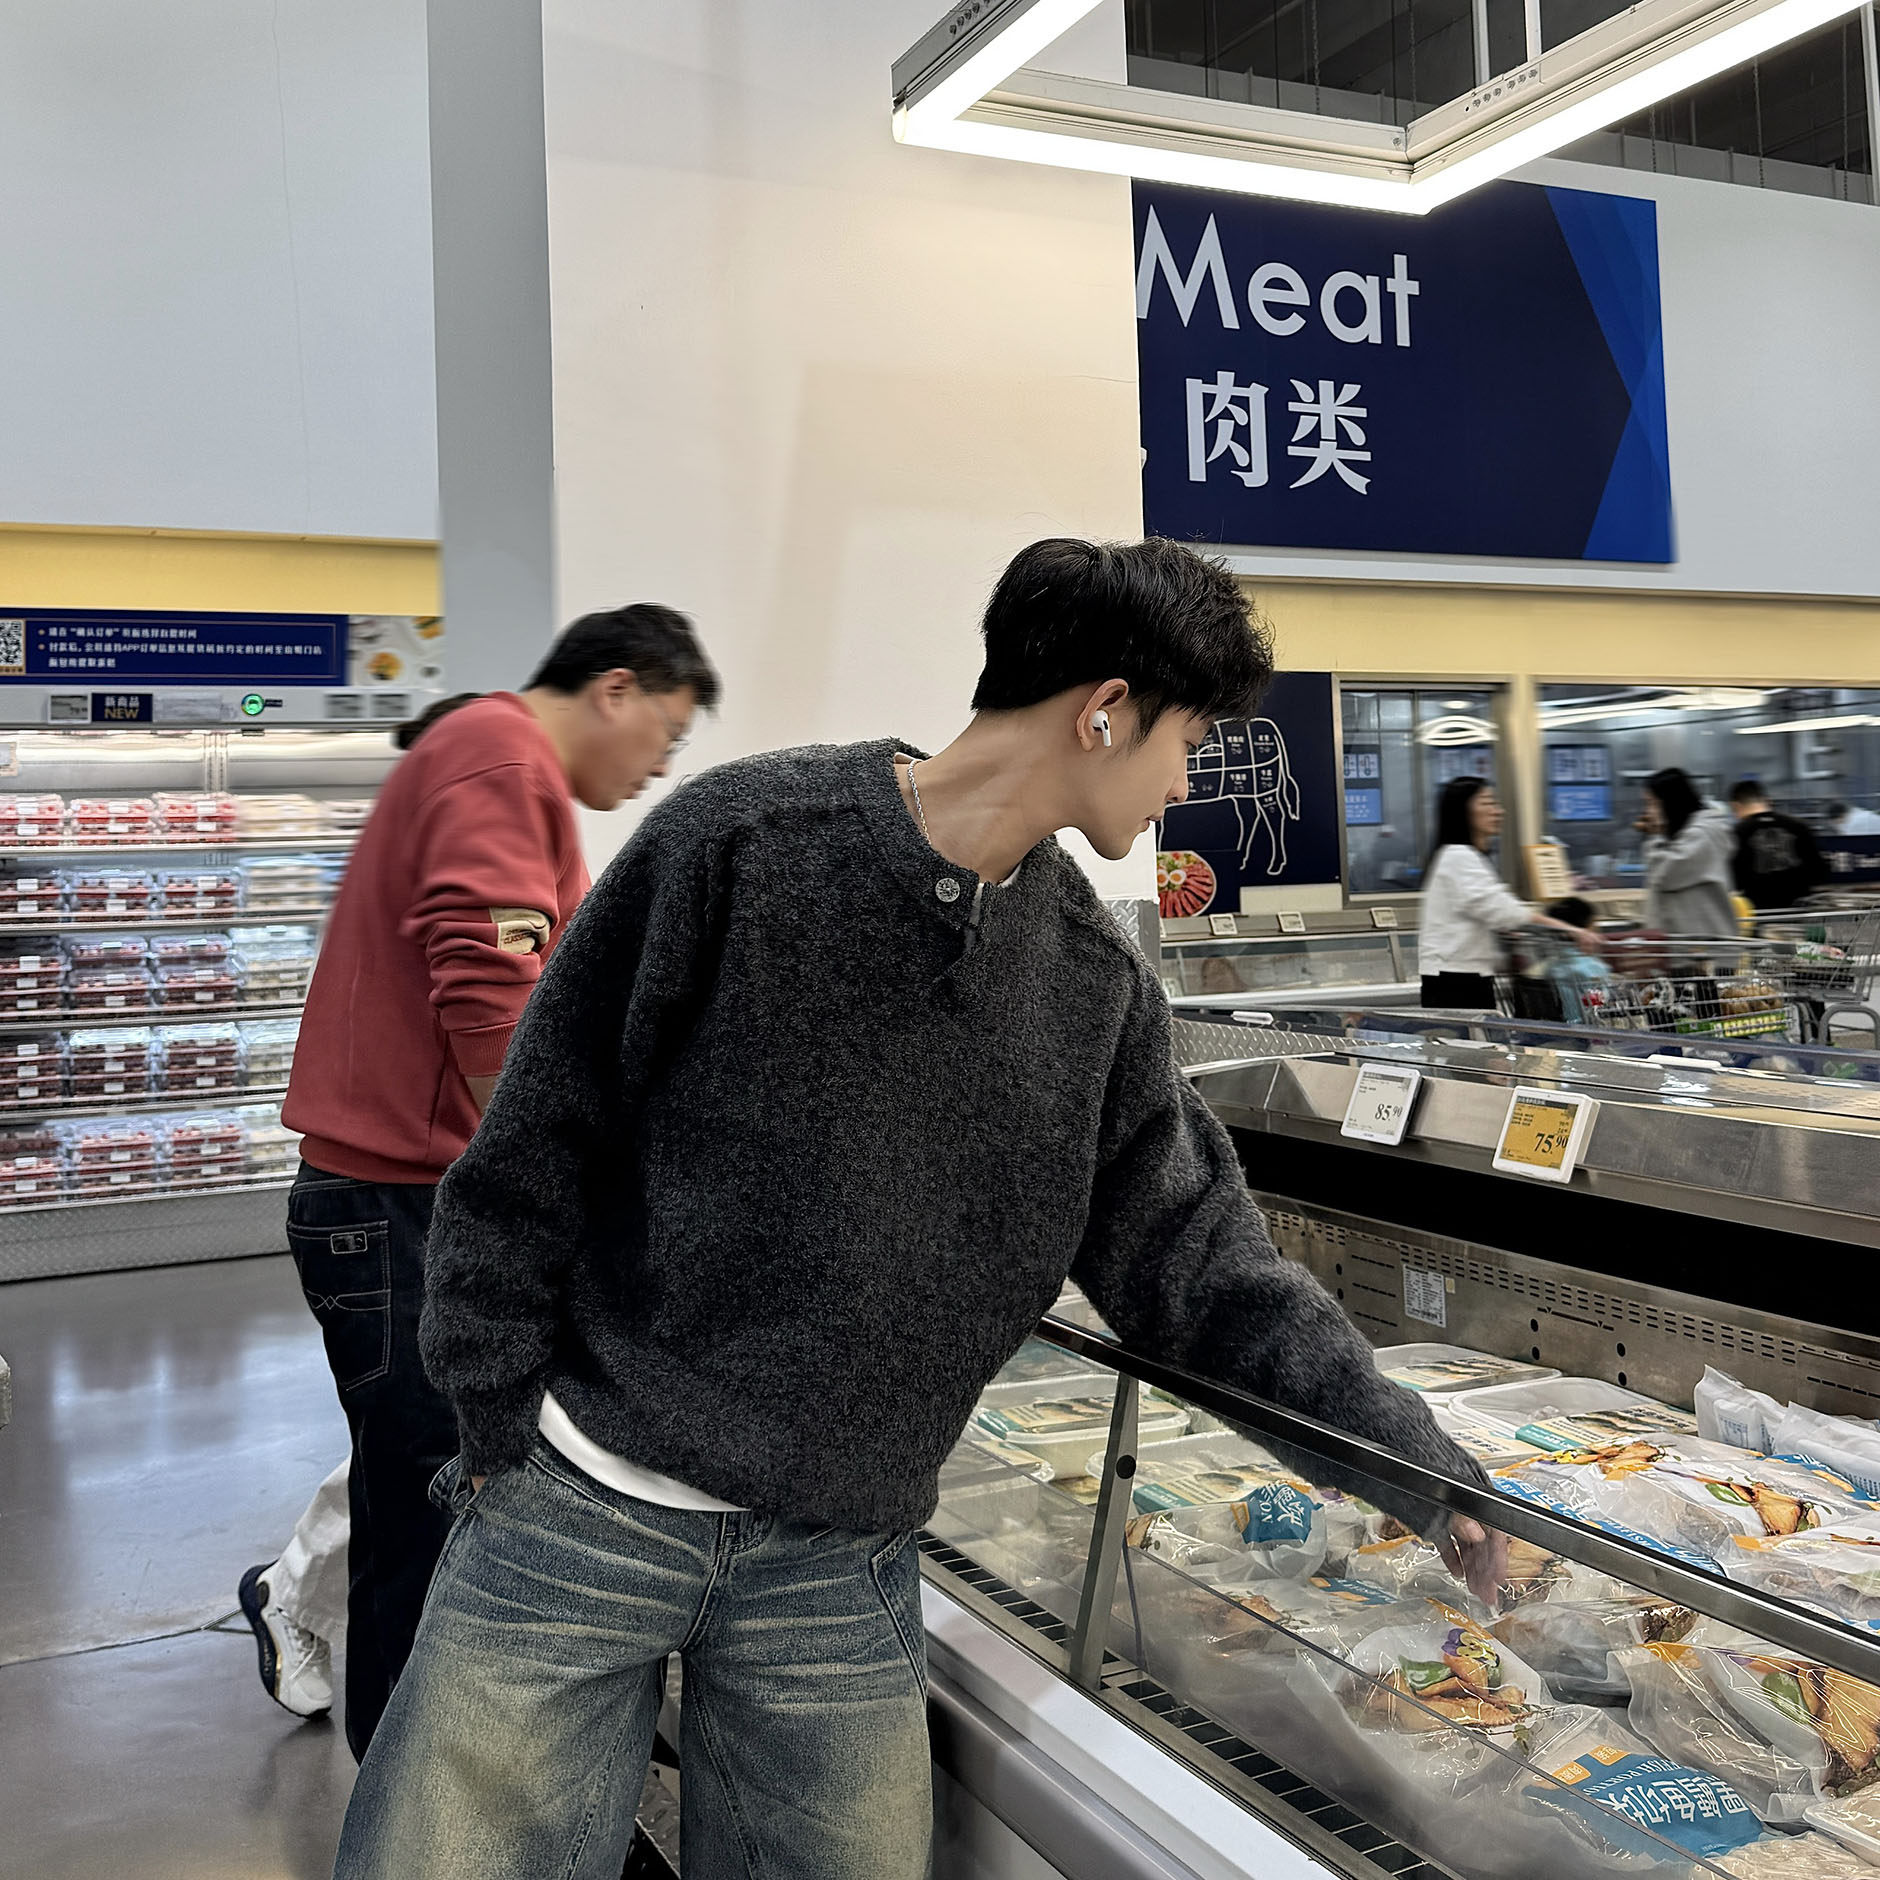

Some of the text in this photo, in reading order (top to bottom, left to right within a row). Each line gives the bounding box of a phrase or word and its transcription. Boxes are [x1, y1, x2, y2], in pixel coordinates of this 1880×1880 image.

[1136, 203, 1421, 348] Meat
[1185, 370, 1372, 496] 肉类
[103, 708, 140, 719] NEW
